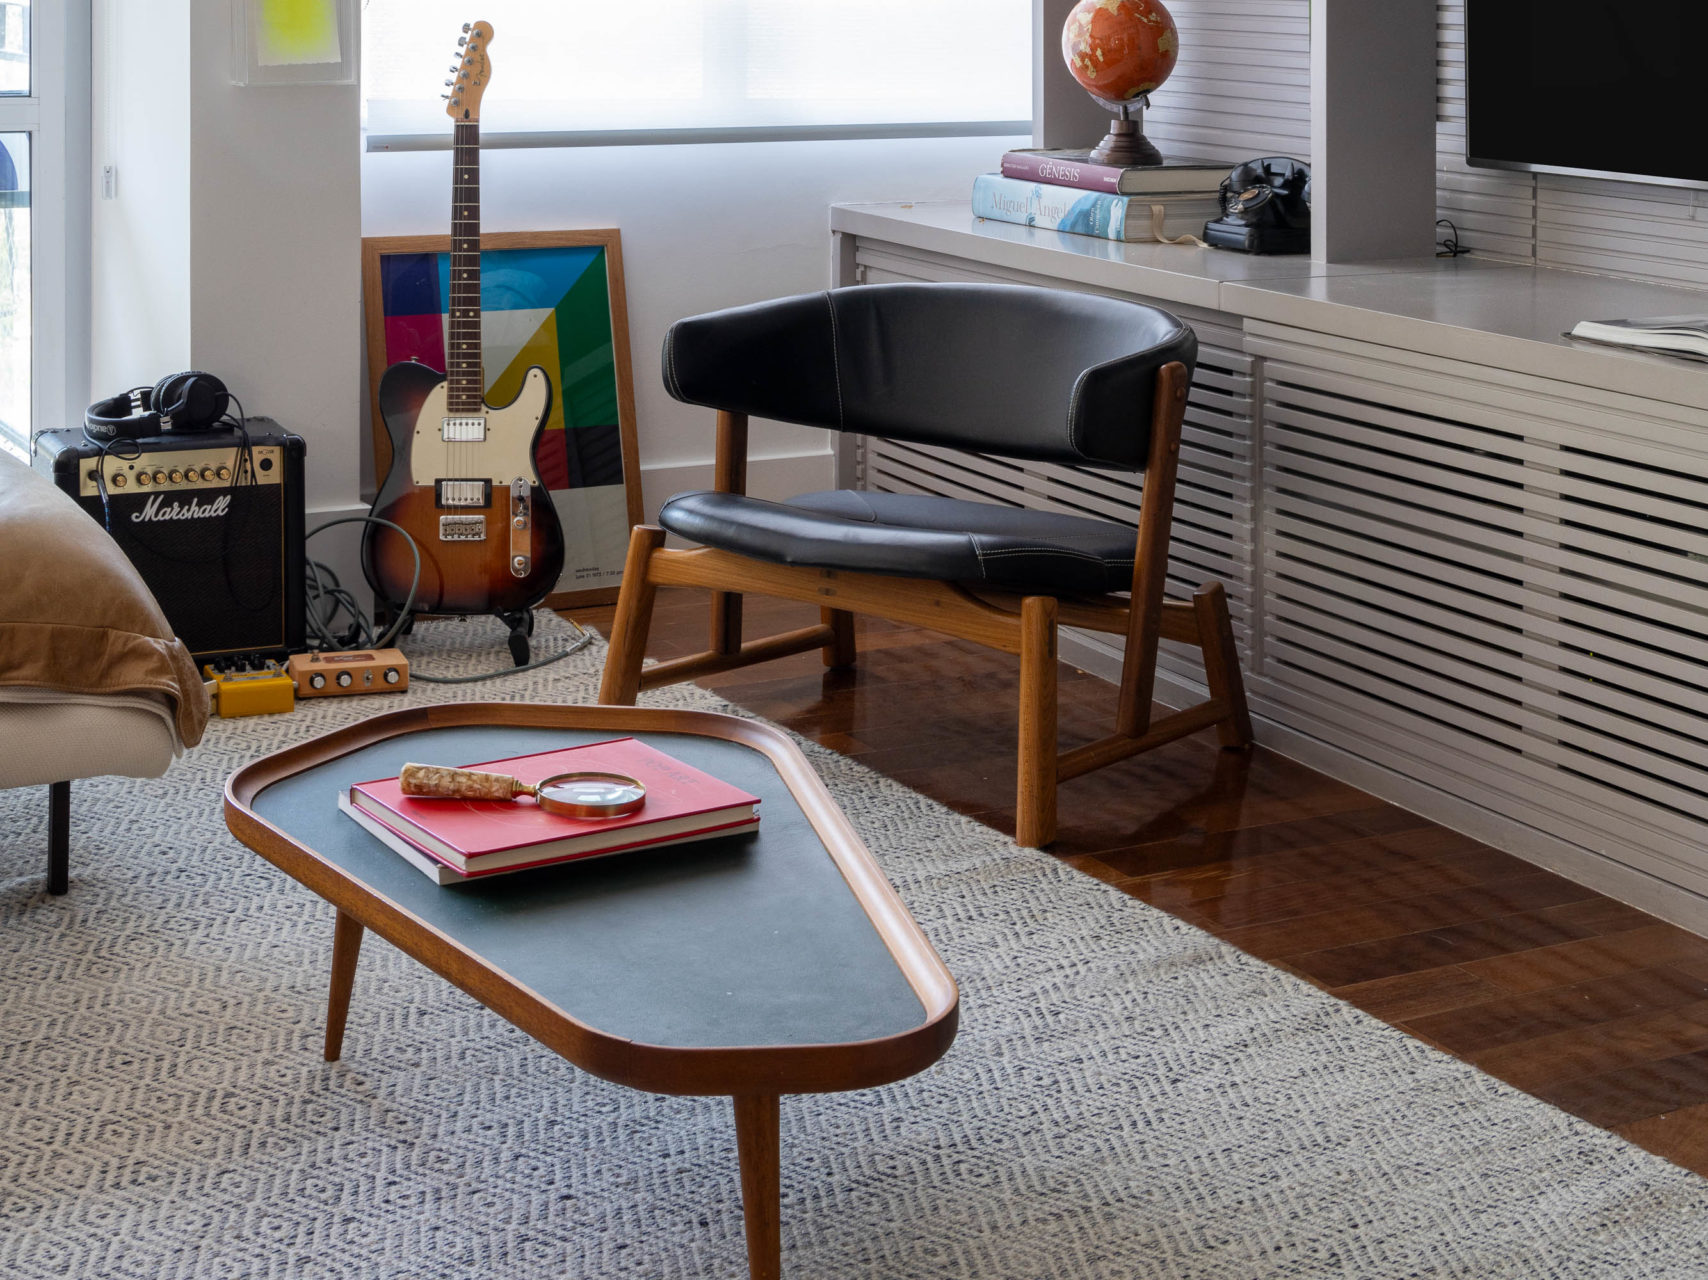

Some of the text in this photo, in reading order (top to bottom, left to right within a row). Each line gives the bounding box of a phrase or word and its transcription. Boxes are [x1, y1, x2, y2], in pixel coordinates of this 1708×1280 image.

[1038, 161, 1080, 182] GÊNESIS
[991, 191, 1029, 216] Miguel
[131, 494, 231, 523] Marshall
